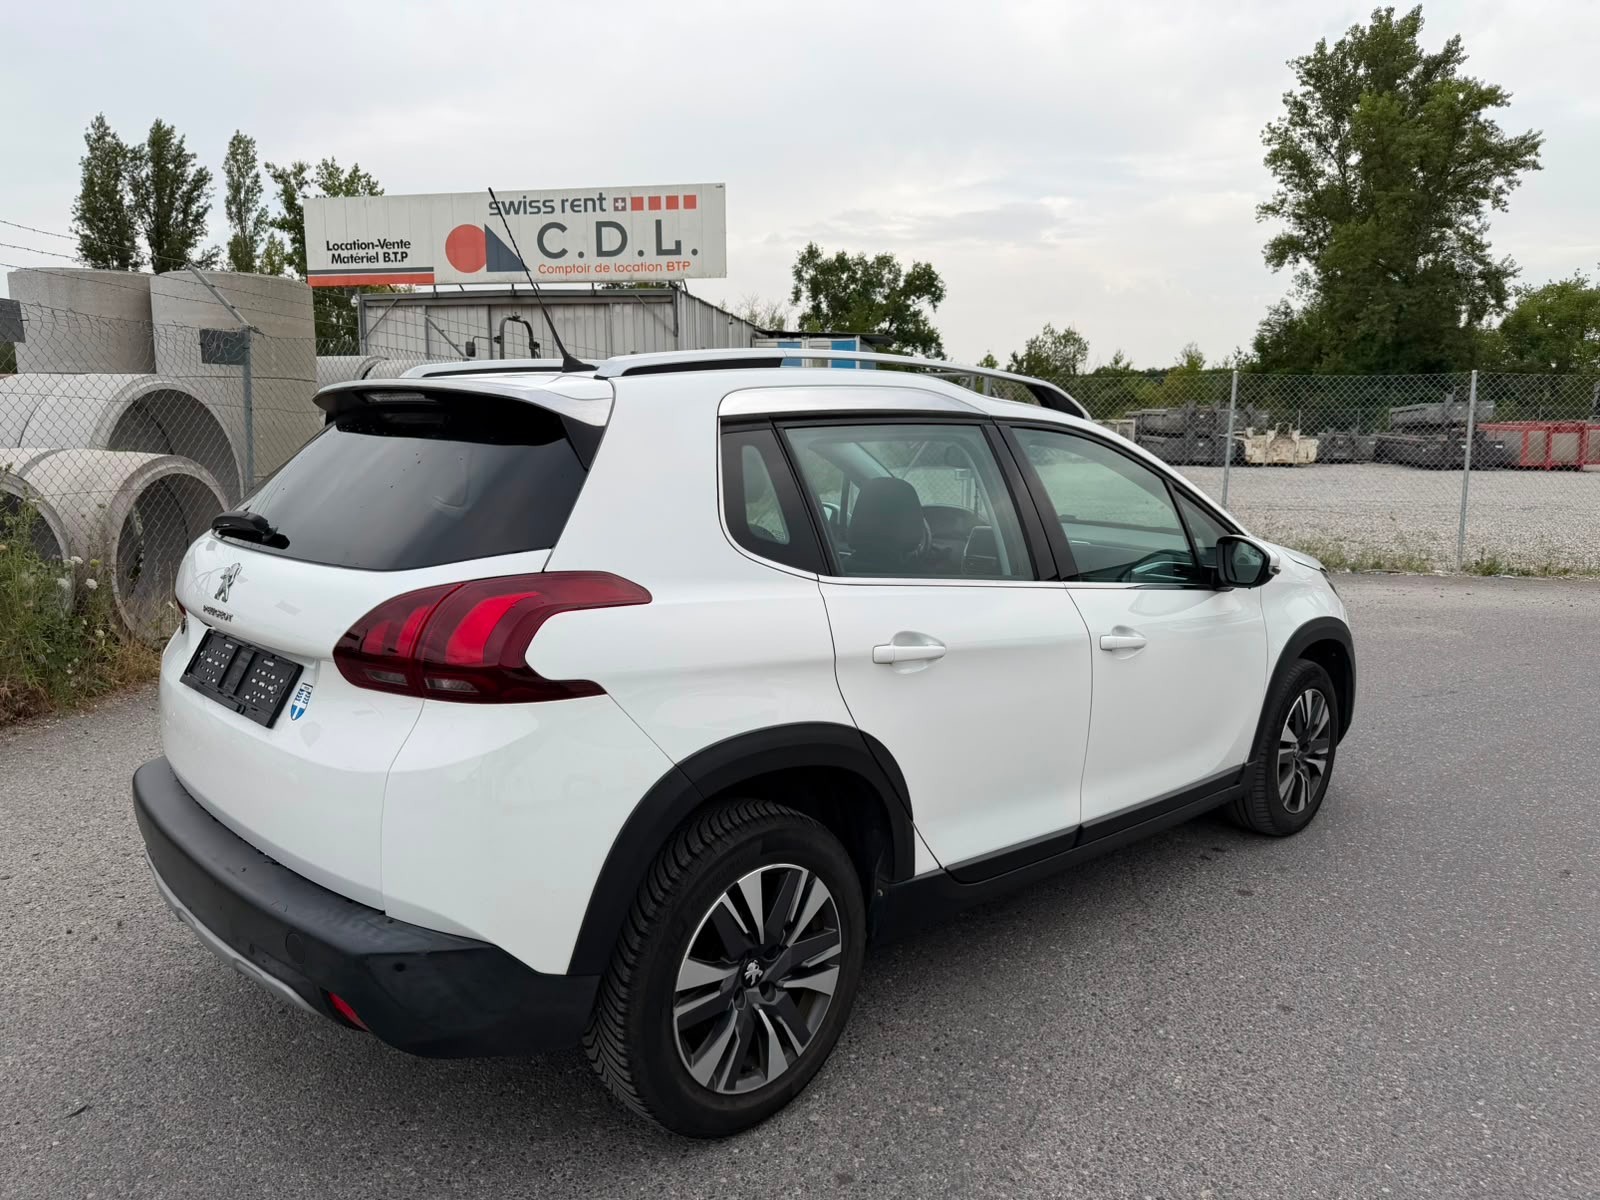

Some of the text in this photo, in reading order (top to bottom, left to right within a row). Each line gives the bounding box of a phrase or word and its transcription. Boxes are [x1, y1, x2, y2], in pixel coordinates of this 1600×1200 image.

[488, 192, 606, 216] swiss rent
[326, 238, 411, 251] Location-Vente
[331, 251, 408, 264] Matériel B.T.P
[538, 261, 691, 276] Comptoir de location BTP
